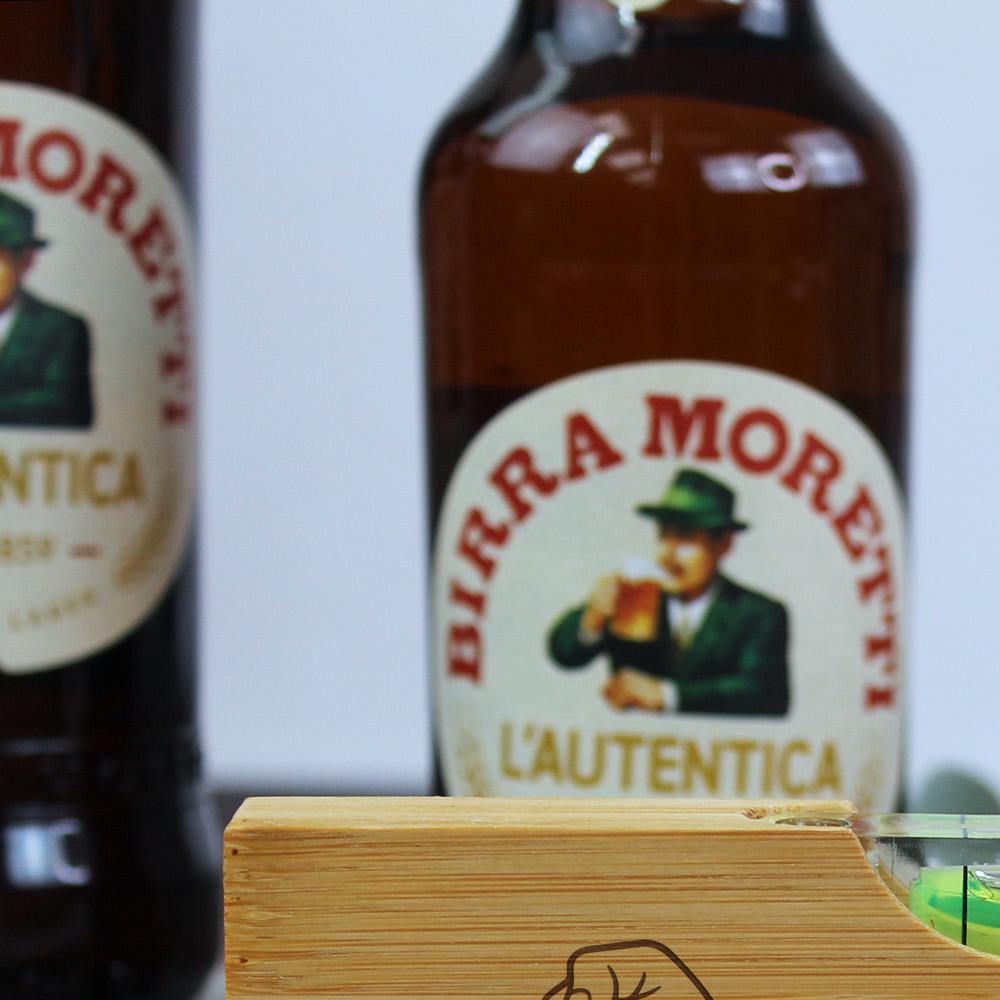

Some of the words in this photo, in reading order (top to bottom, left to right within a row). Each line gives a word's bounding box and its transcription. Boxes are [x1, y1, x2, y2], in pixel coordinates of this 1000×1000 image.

[0, 118, 190, 427] ORETTI
[447, 412, 624, 685] BIRRA
[642, 394, 896, 709] MORETTI
[501, 722, 845, 796] L'AUTENTICA
